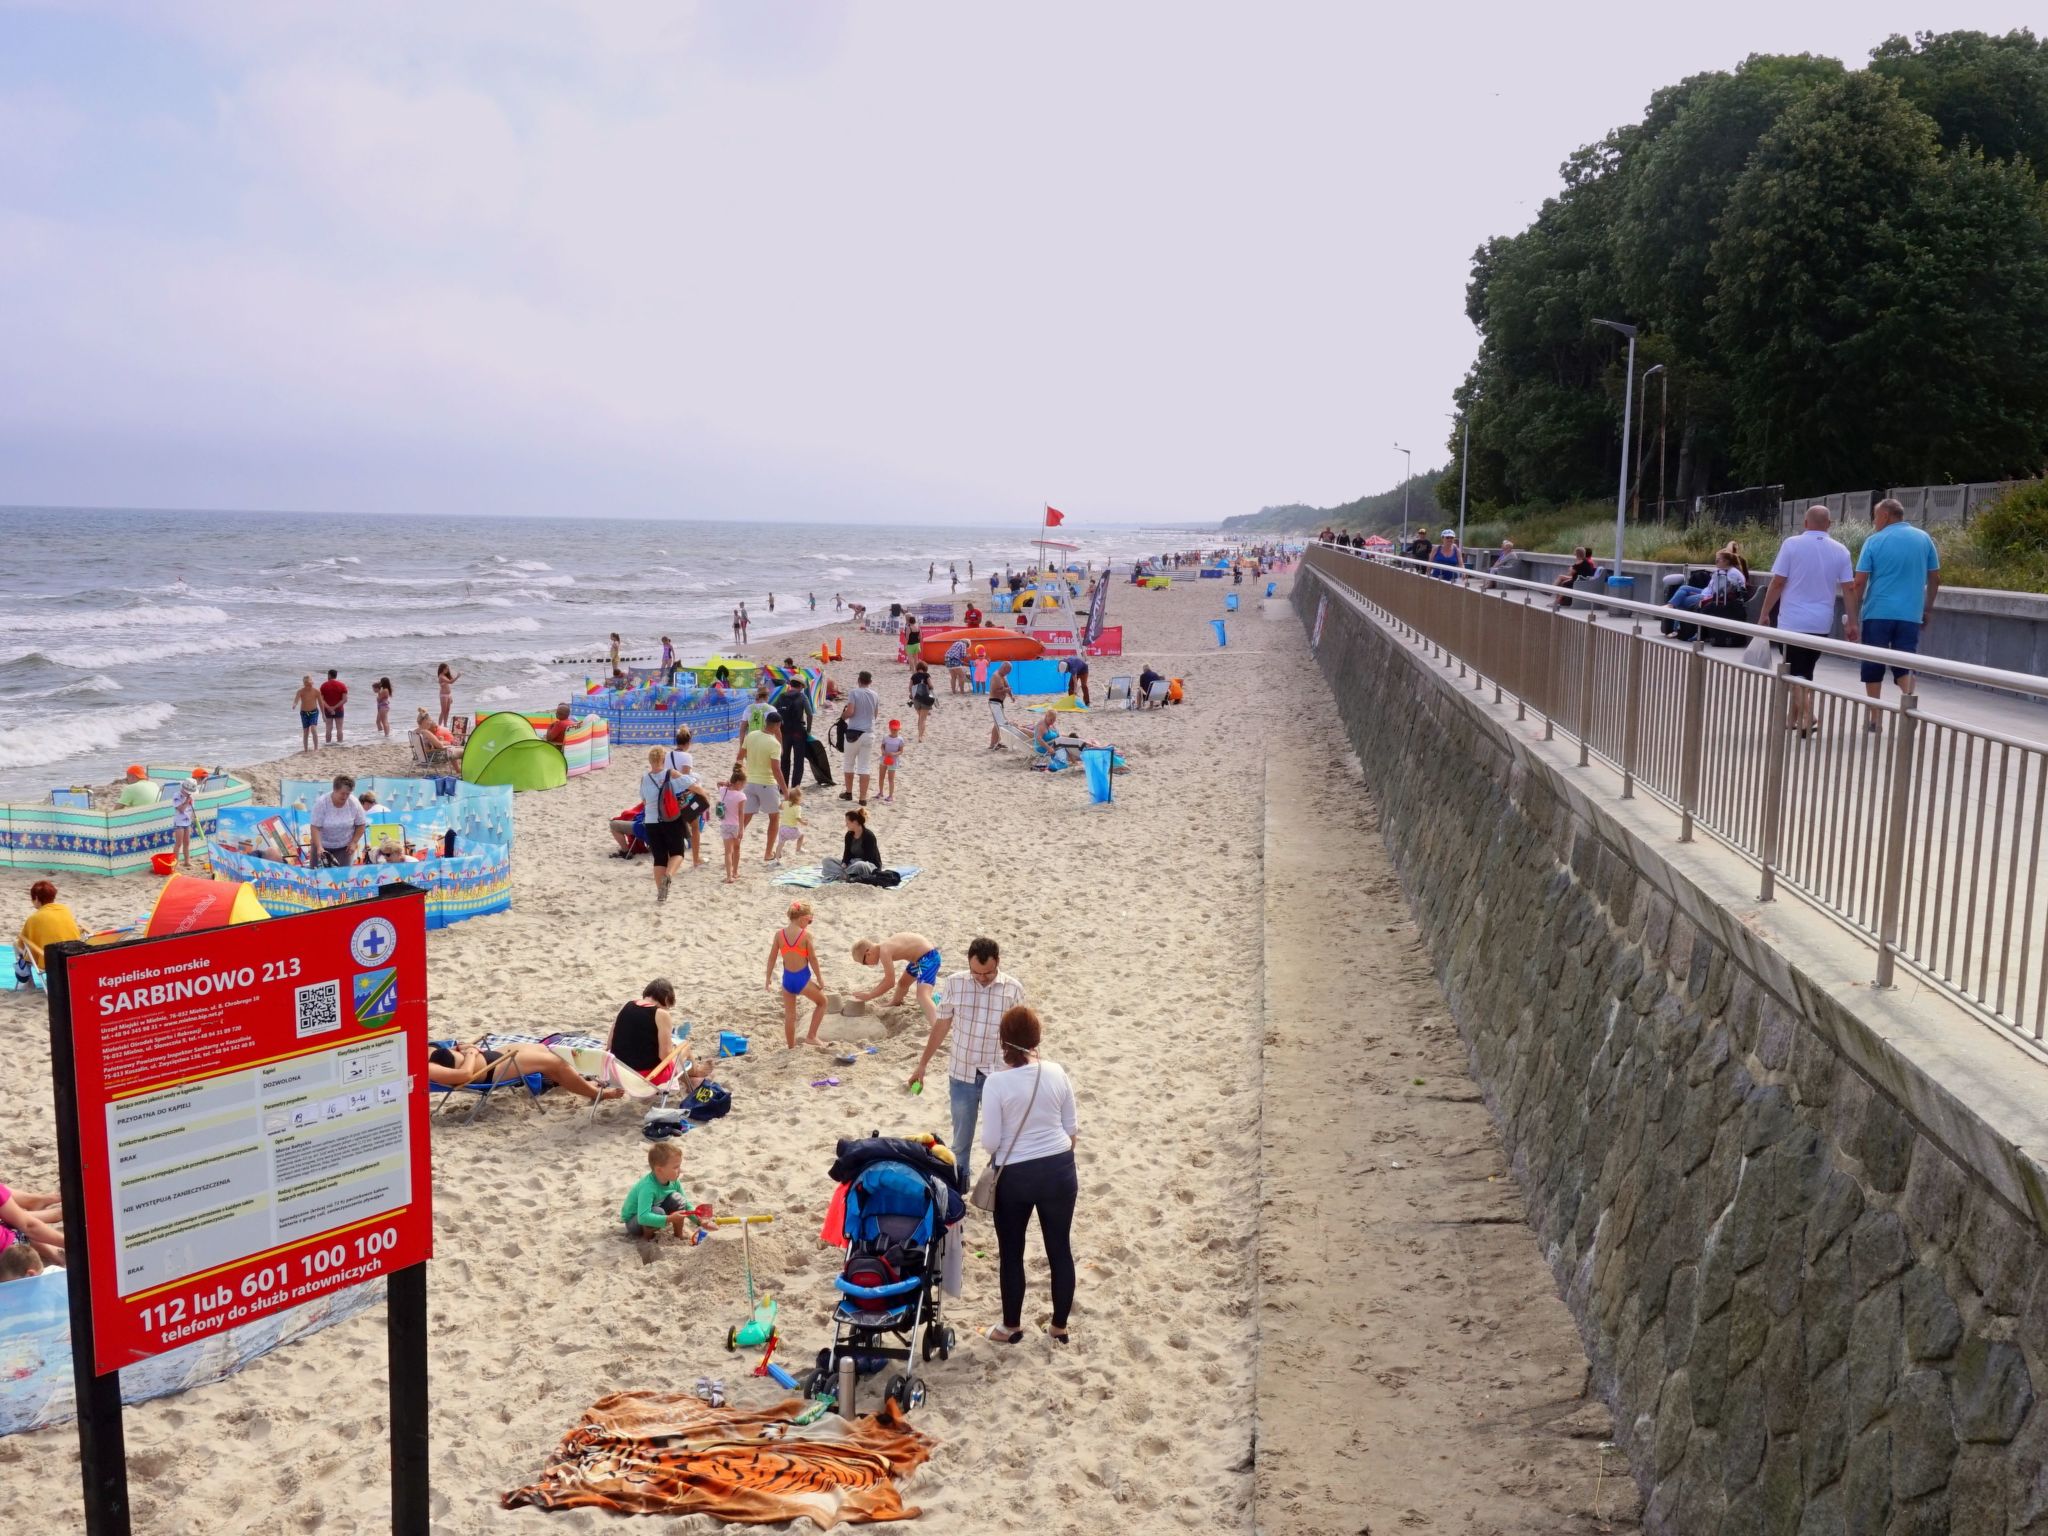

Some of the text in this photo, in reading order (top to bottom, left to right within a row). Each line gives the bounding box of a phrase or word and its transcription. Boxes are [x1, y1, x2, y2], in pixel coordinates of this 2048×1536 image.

[99, 958, 210, 987] Kąpielisko morskie
[100, 958, 300, 1014] SARBINOWO 213
[118, 1021, 139, 1029] Miejski
[263, 1075, 301, 1088] DOZWOLONA
[117, 1111, 155, 1124] PRZYDATNA
[168, 1102, 191, 1112] KĄPIELI
[120, 1154, 136, 1163] BRAK
[135, 1195, 171, 1209] WYSTĘPUJĄ
[173, 1179, 230, 1198] ZANIECZYSZCZENIA
[127, 1265, 144, 1275] BRAK
[140, 1228, 397, 1331] 112 lub 601 100 100
[162, 1258, 381, 1342] telefony do służb ratowniczych
